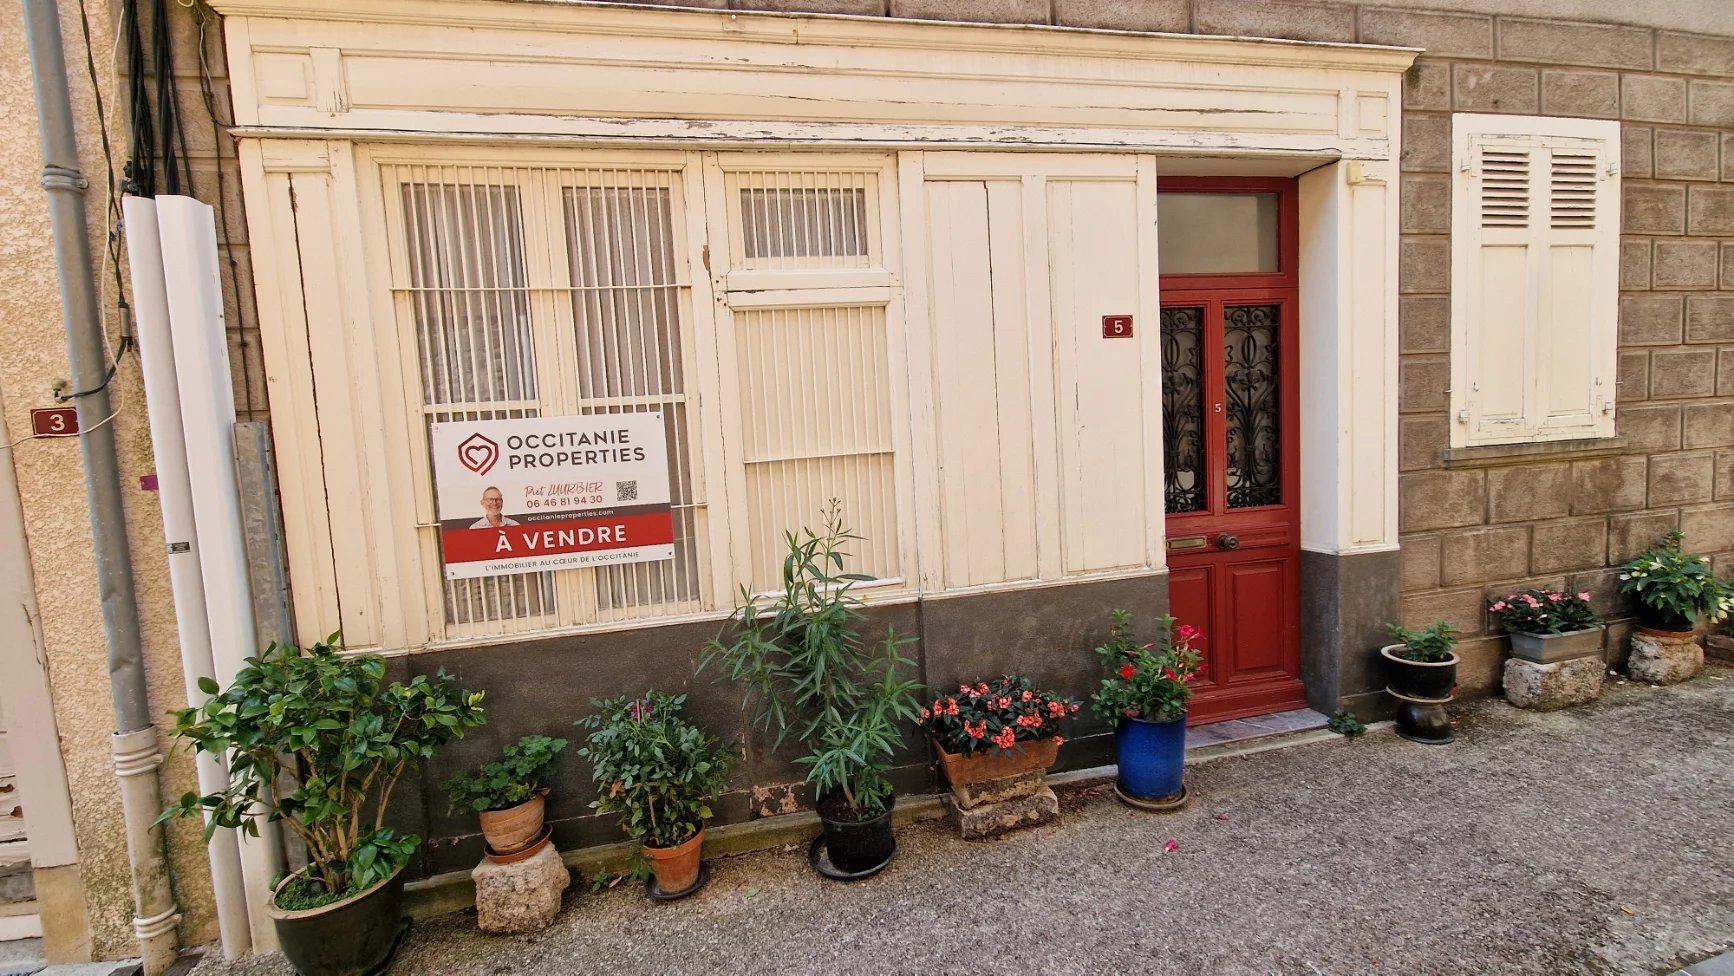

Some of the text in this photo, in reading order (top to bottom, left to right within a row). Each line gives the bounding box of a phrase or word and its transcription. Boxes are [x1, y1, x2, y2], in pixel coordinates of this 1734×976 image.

[1114, 320, 1124, 333] 5
[1215, 403, 1222, 413] 5
[50, 414, 65, 431] 3
[507, 429, 629, 450] OCCITANIE
[510, 447, 645, 469] PROPERTIES
[527, 495, 602, 508] 06 46 81 94 30
[528, 509, 613, 522] occitanieproperties.com
[495, 525, 627, 553] À VENDRE
[485, 552, 639, 571] L'IMMOBILIER AU CŒUR DE L'OCCITANIE
